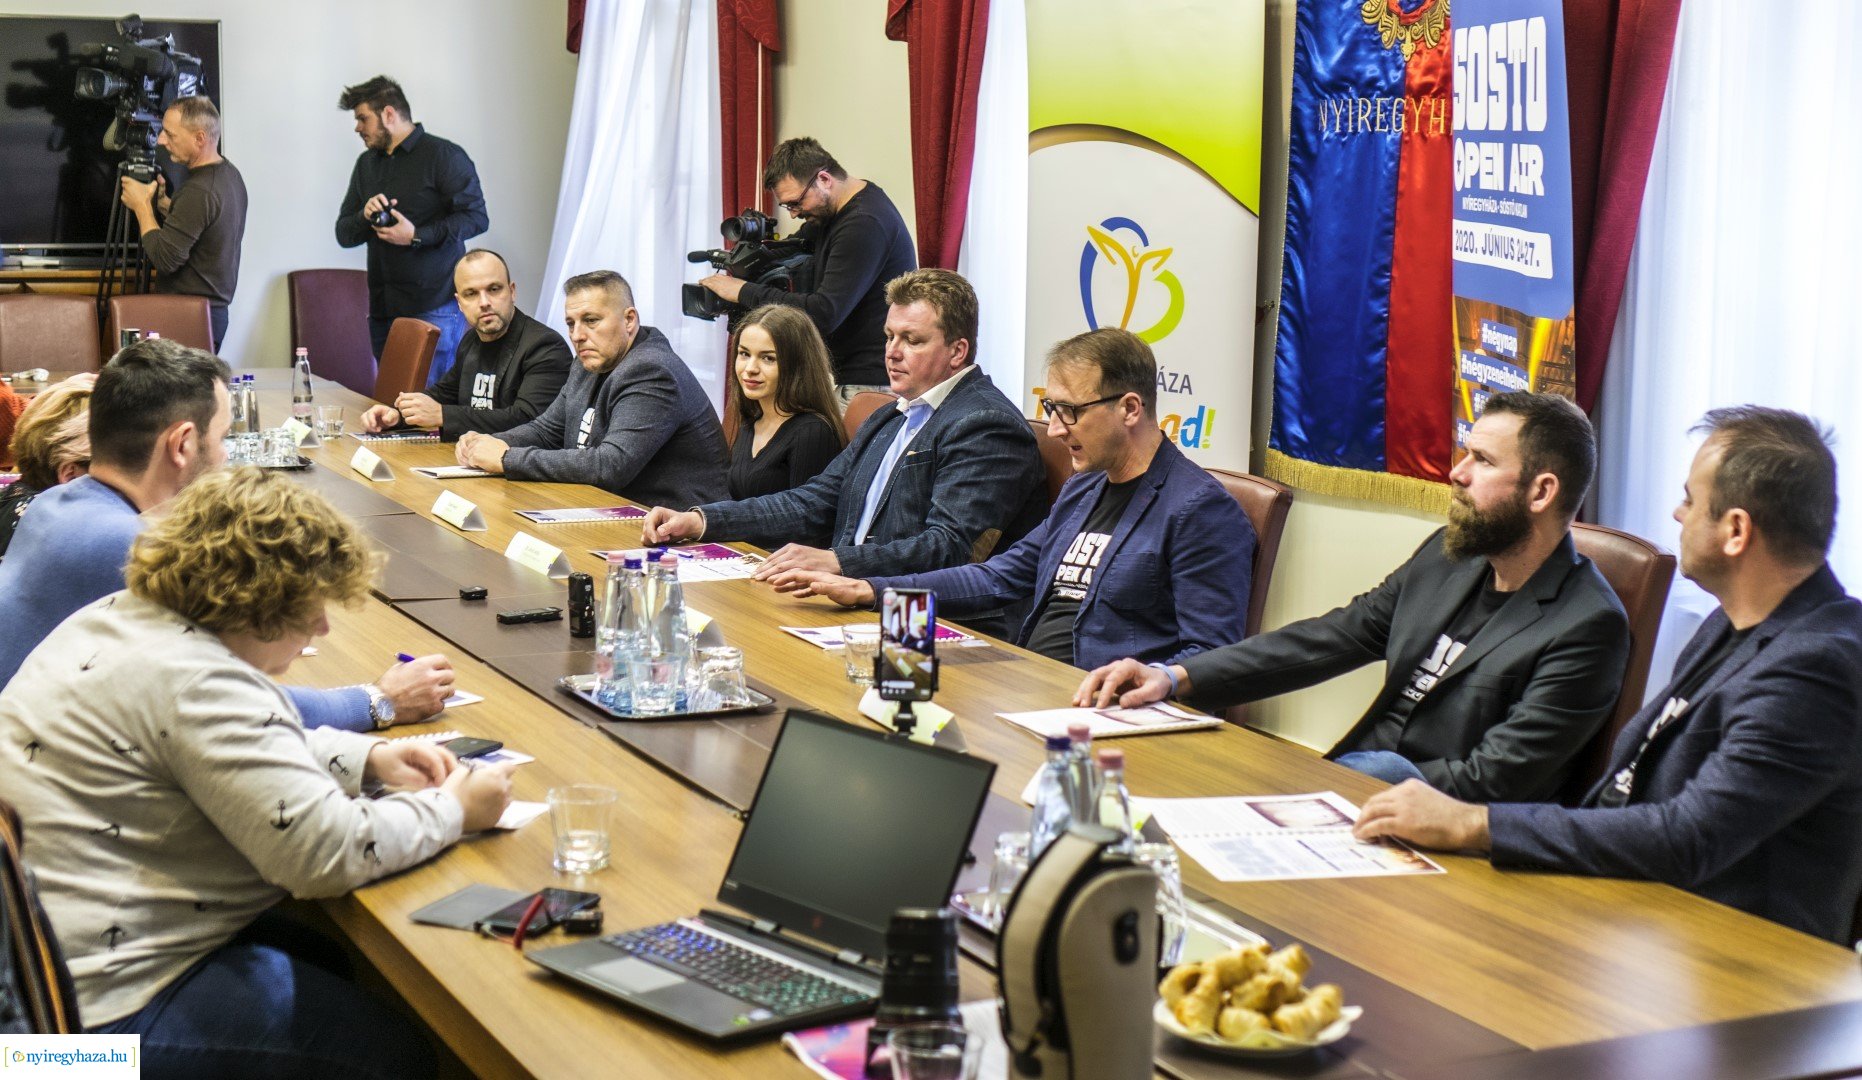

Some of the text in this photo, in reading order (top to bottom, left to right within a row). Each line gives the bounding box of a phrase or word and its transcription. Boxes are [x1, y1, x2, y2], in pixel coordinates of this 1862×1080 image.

[1318, 87, 1453, 135] NYÍREGYH
[1453, 137, 1545, 197] OPEN AIR
[1455, 229, 1478, 254] 2020.
[1482, 228, 1515, 261] JÚNIUS
[1157, 366, 1193, 396] ÁZA
[1063, 531, 1112, 567] OST
[1055, 564, 1083, 583] PEN
